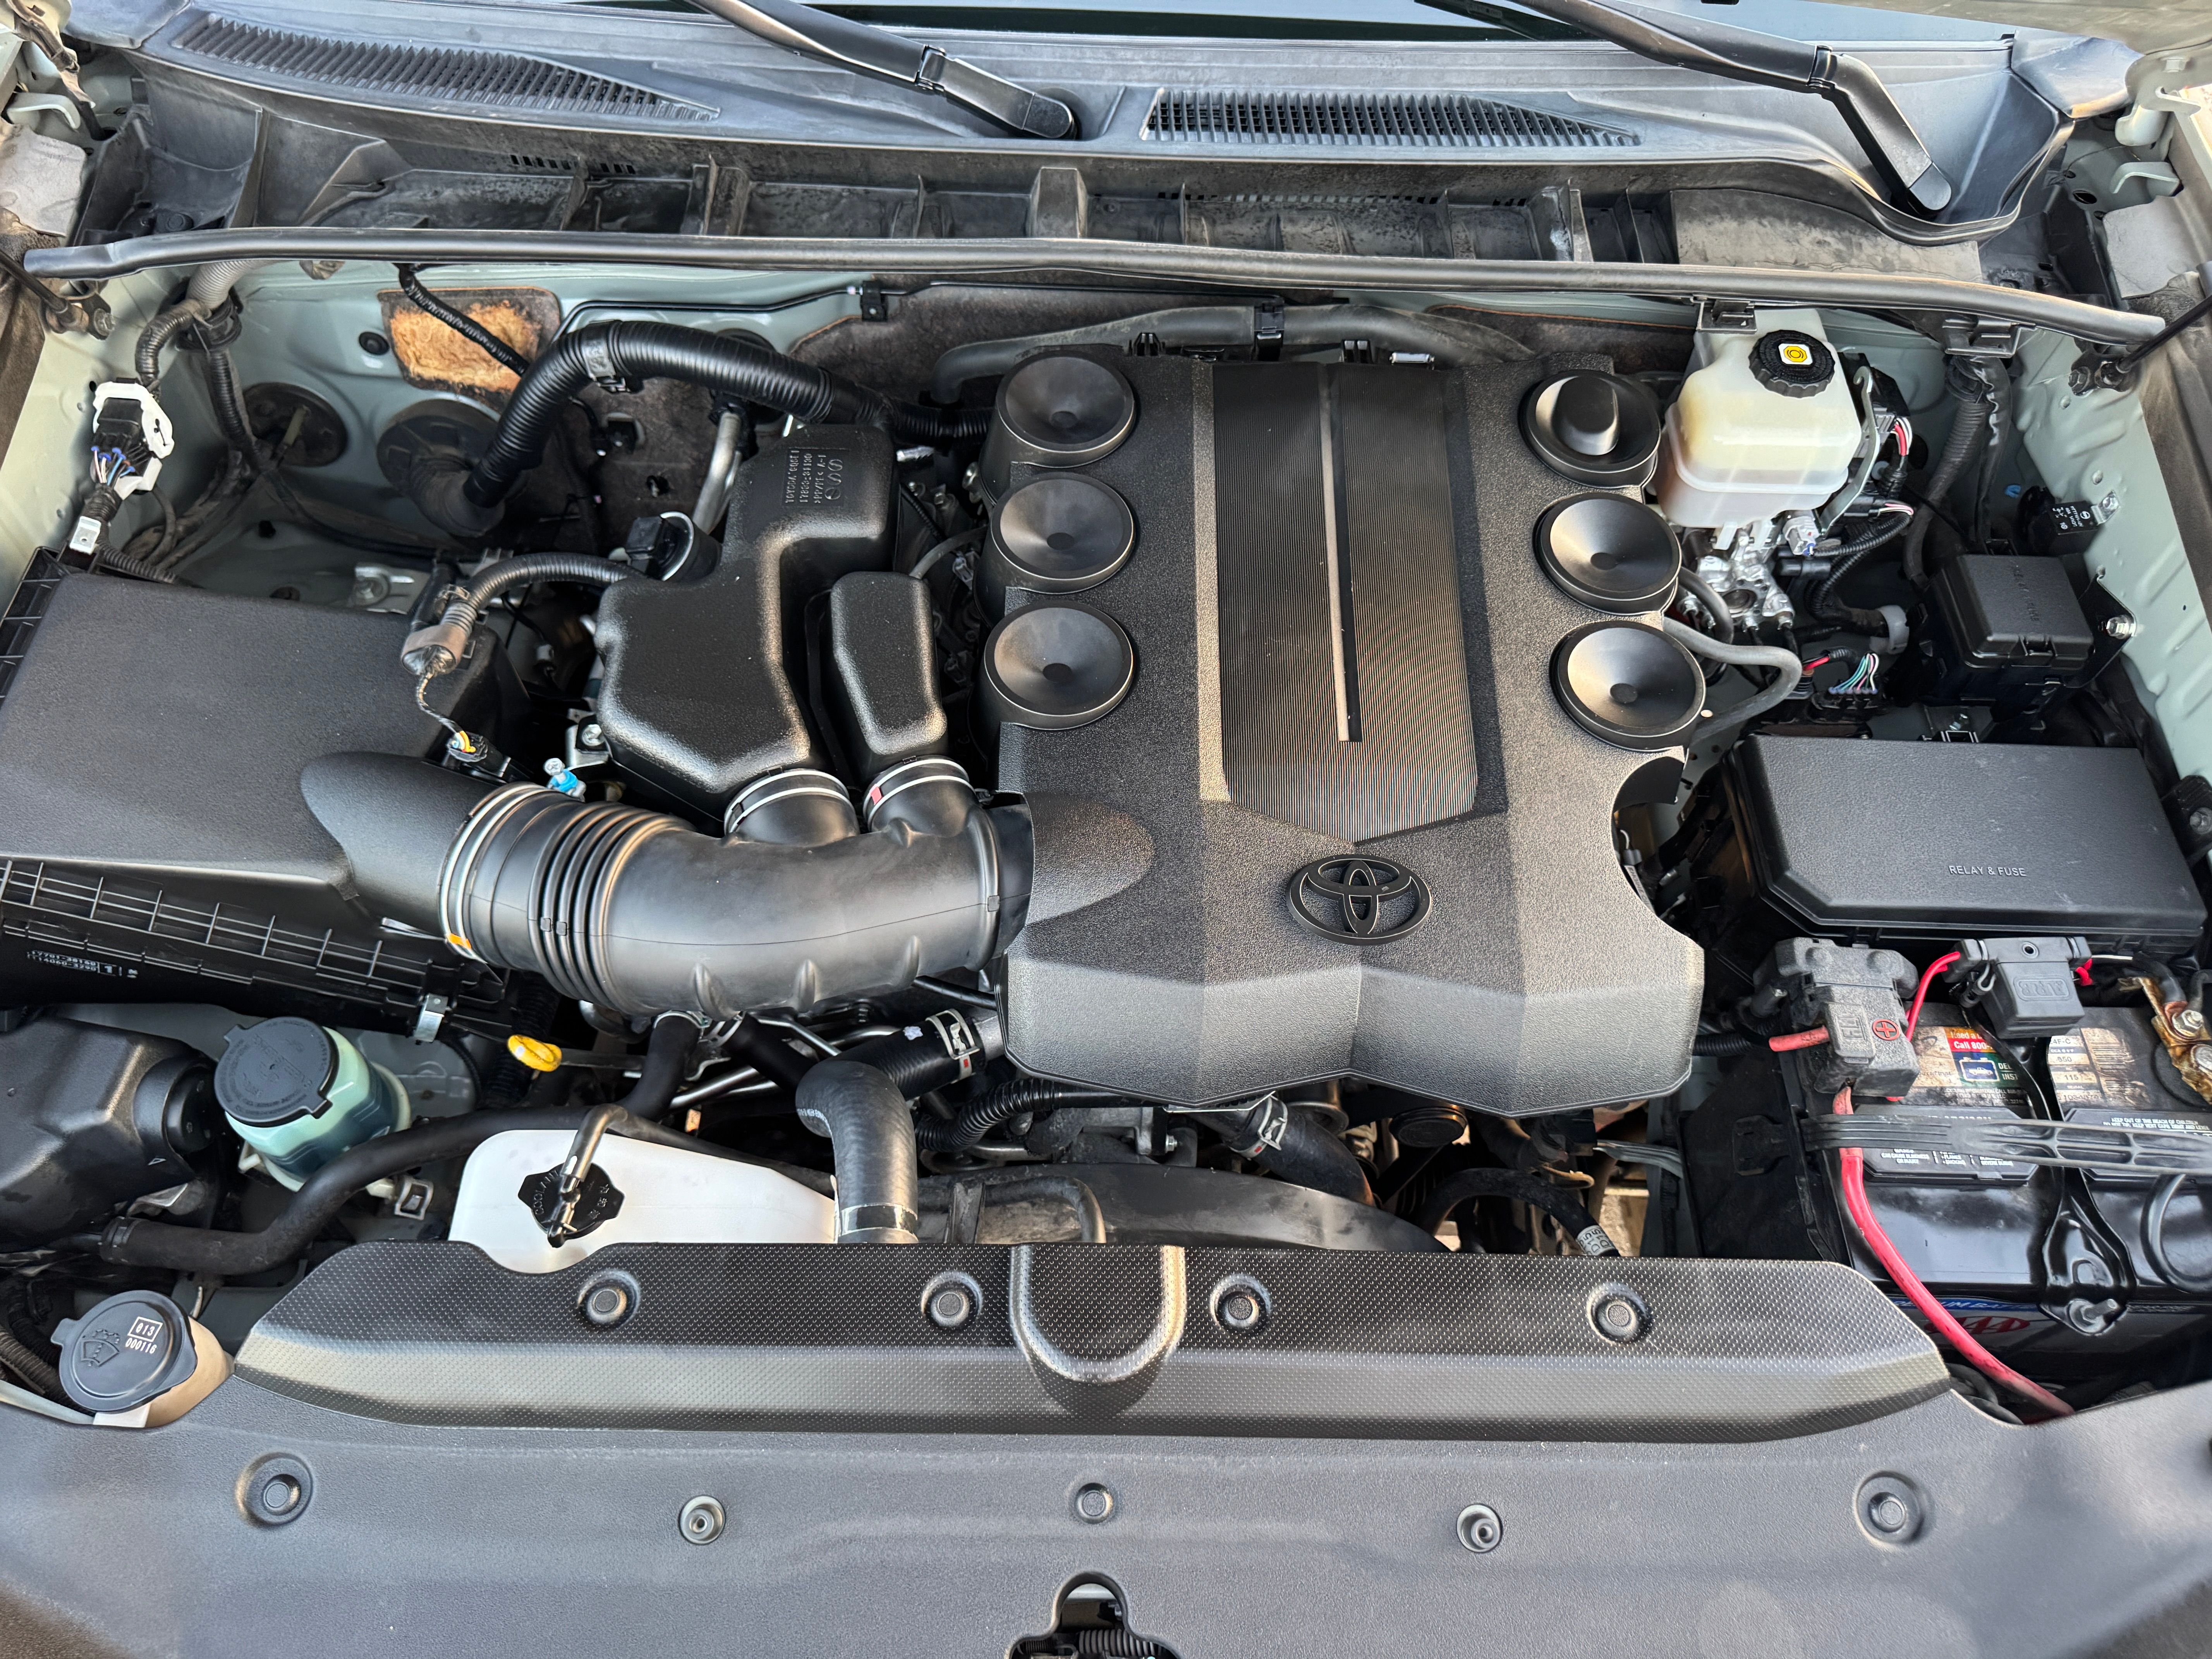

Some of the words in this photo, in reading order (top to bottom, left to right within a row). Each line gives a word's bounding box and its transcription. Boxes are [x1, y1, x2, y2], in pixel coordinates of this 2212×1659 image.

[1949, 865, 1984, 875] RELAY
[1987, 866, 1996, 876] &
[1997, 867, 2027, 877] FUSE
[1954, 1041, 1971, 1049] Call
[1583, 1232, 1601, 1253] D15
[1591, 1229, 1610, 1247] D15
[125, 1337, 158, 1355] 000116
